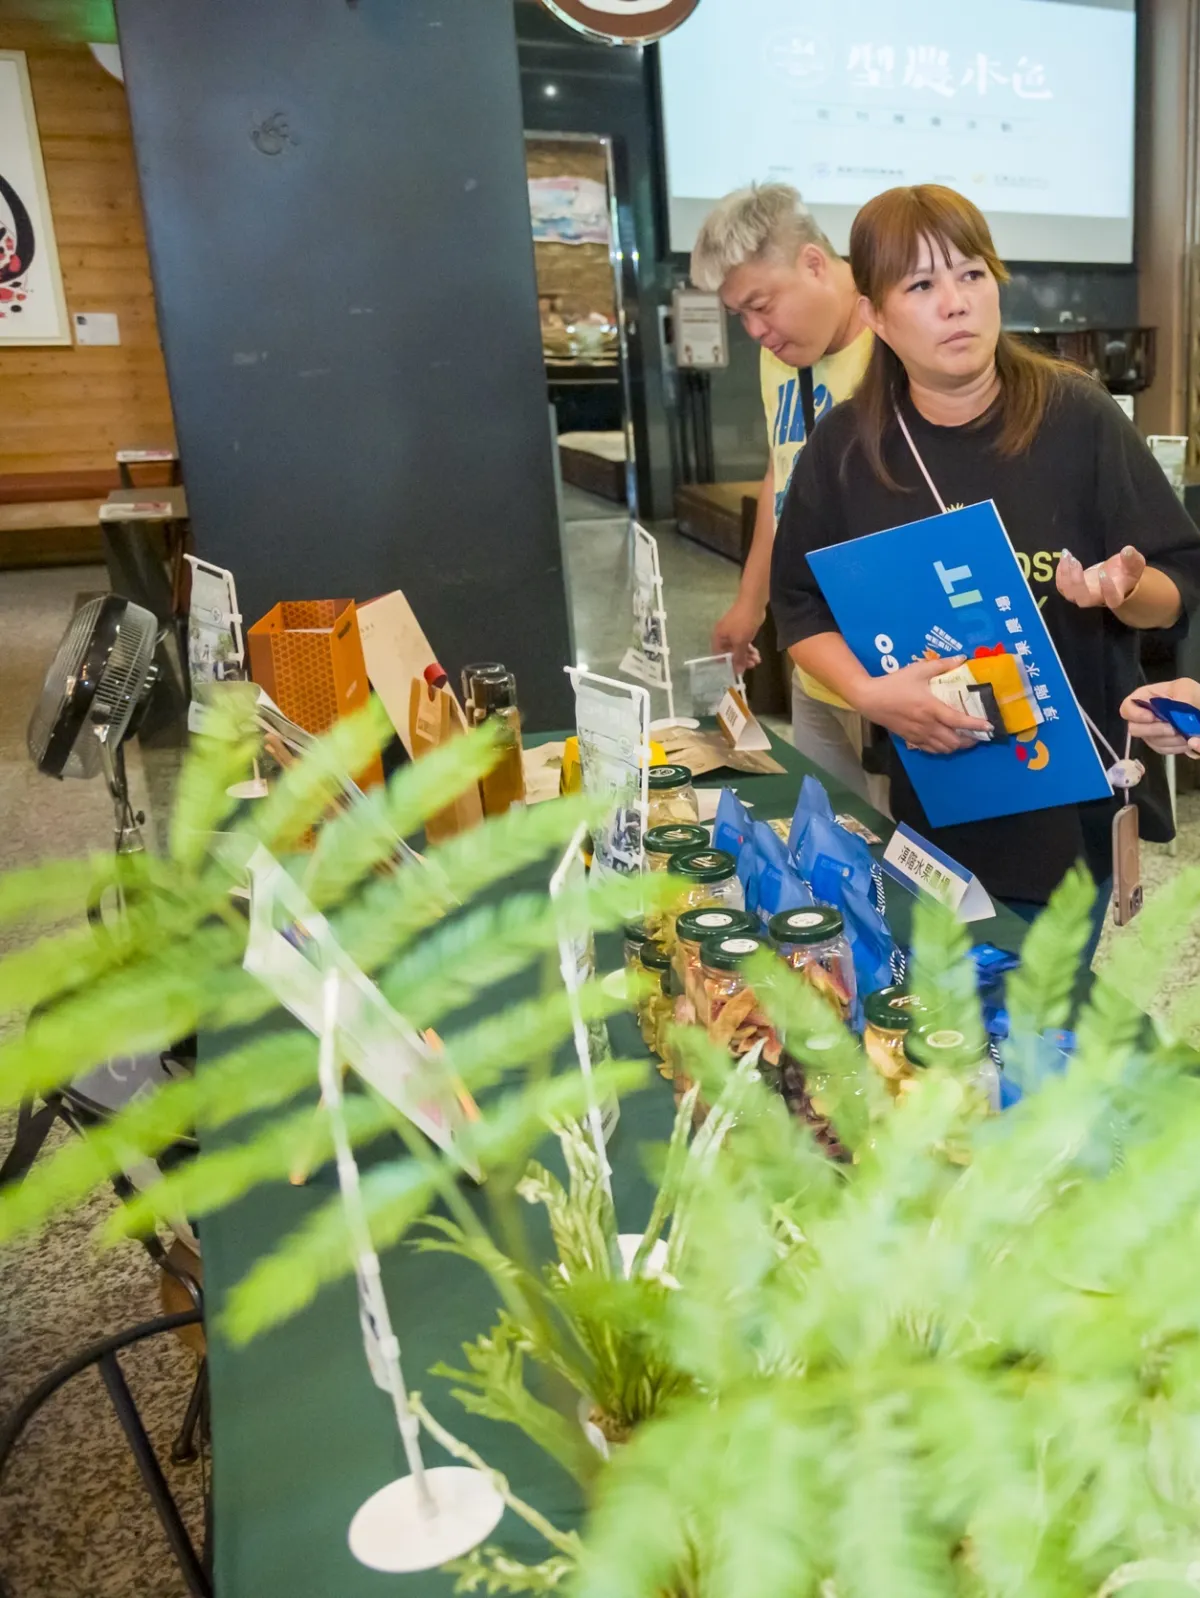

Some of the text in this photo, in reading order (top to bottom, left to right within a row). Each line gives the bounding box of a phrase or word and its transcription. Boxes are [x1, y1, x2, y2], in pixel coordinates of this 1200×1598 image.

[994, 595, 1060, 722] 淳階水果農場
